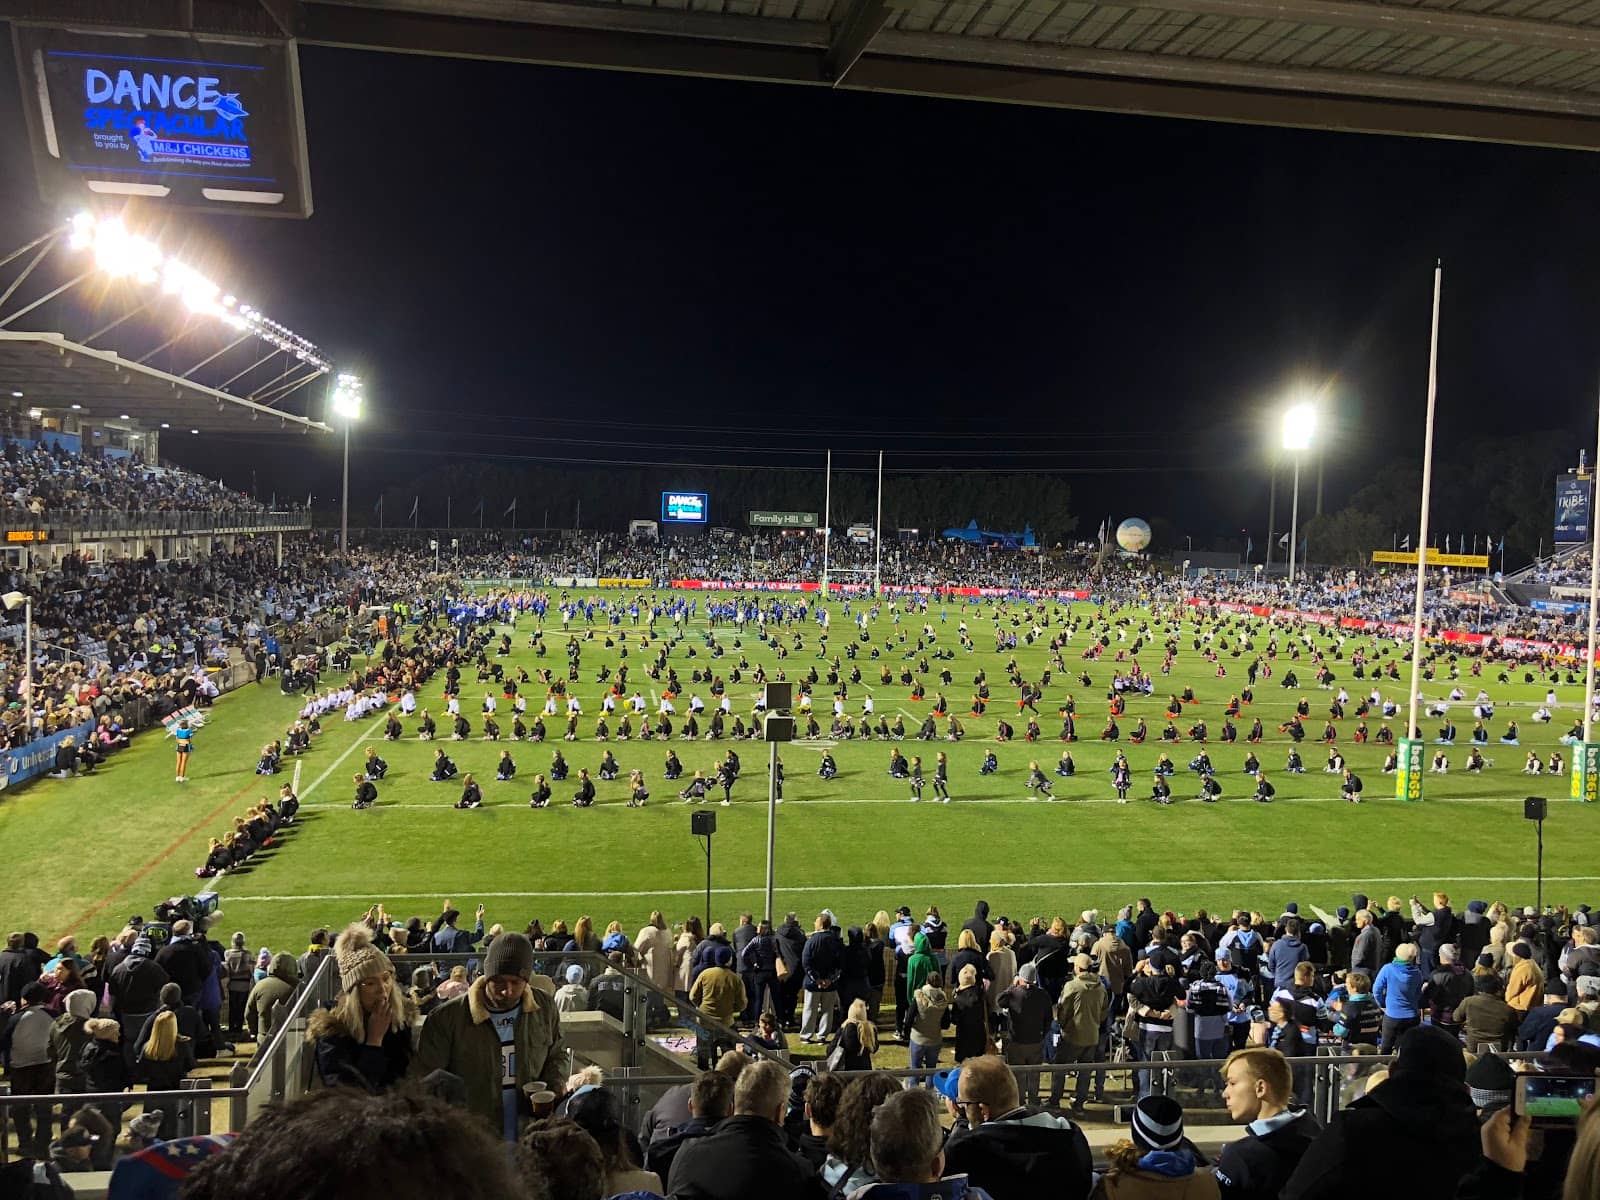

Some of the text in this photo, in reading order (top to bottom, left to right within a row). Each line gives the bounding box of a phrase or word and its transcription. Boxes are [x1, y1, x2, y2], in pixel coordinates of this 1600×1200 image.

[86, 69, 222, 111] DANCE
[84, 107, 247, 142] SPECTACULAR
[93, 132, 124, 142] brought
[120, 142, 130, 150] by
[153, 142, 247, 158] M&J CHICKENS
[1559, 495, 1585, 508] TRIBE
[753, 514, 799, 525] Family Hill
[1408, 745, 1423, 798] bet365
[1586, 747, 1599, 801] bet365
